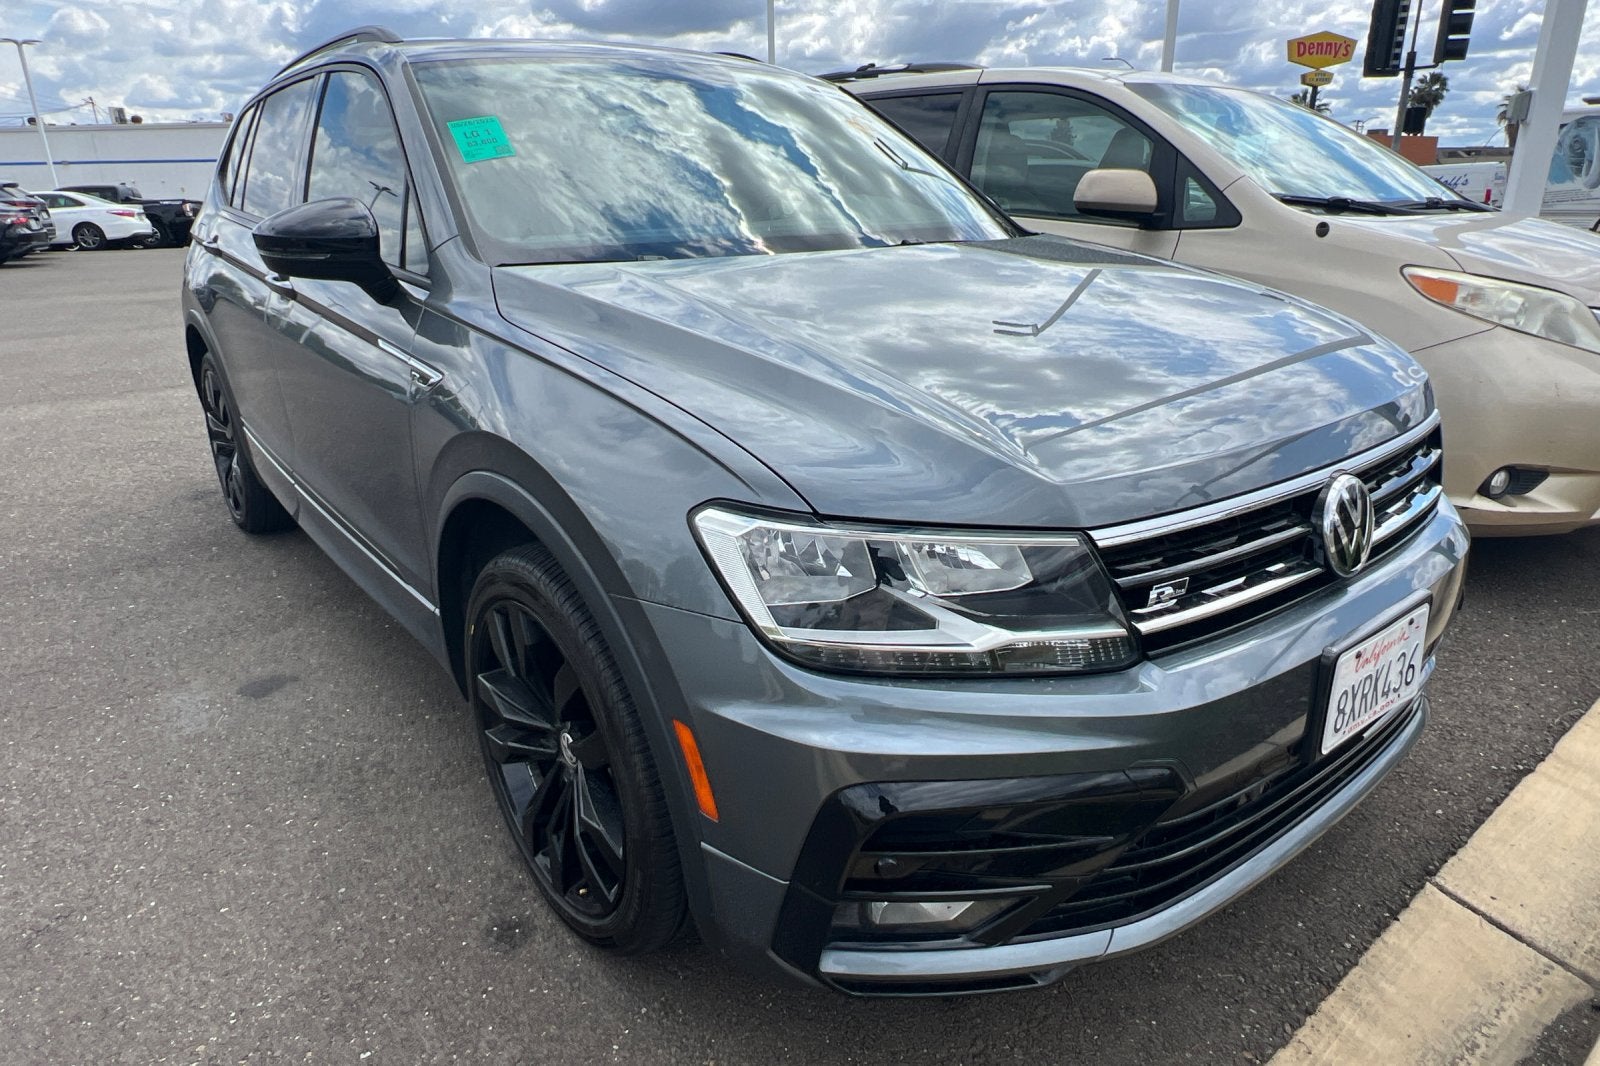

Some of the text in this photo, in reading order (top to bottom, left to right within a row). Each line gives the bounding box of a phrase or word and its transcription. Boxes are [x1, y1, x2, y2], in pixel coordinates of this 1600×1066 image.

[1296, 40, 1351, 58] Denny's
[1355, 627, 1410, 673] California
[1334, 642, 1420, 734] 8XRK436
